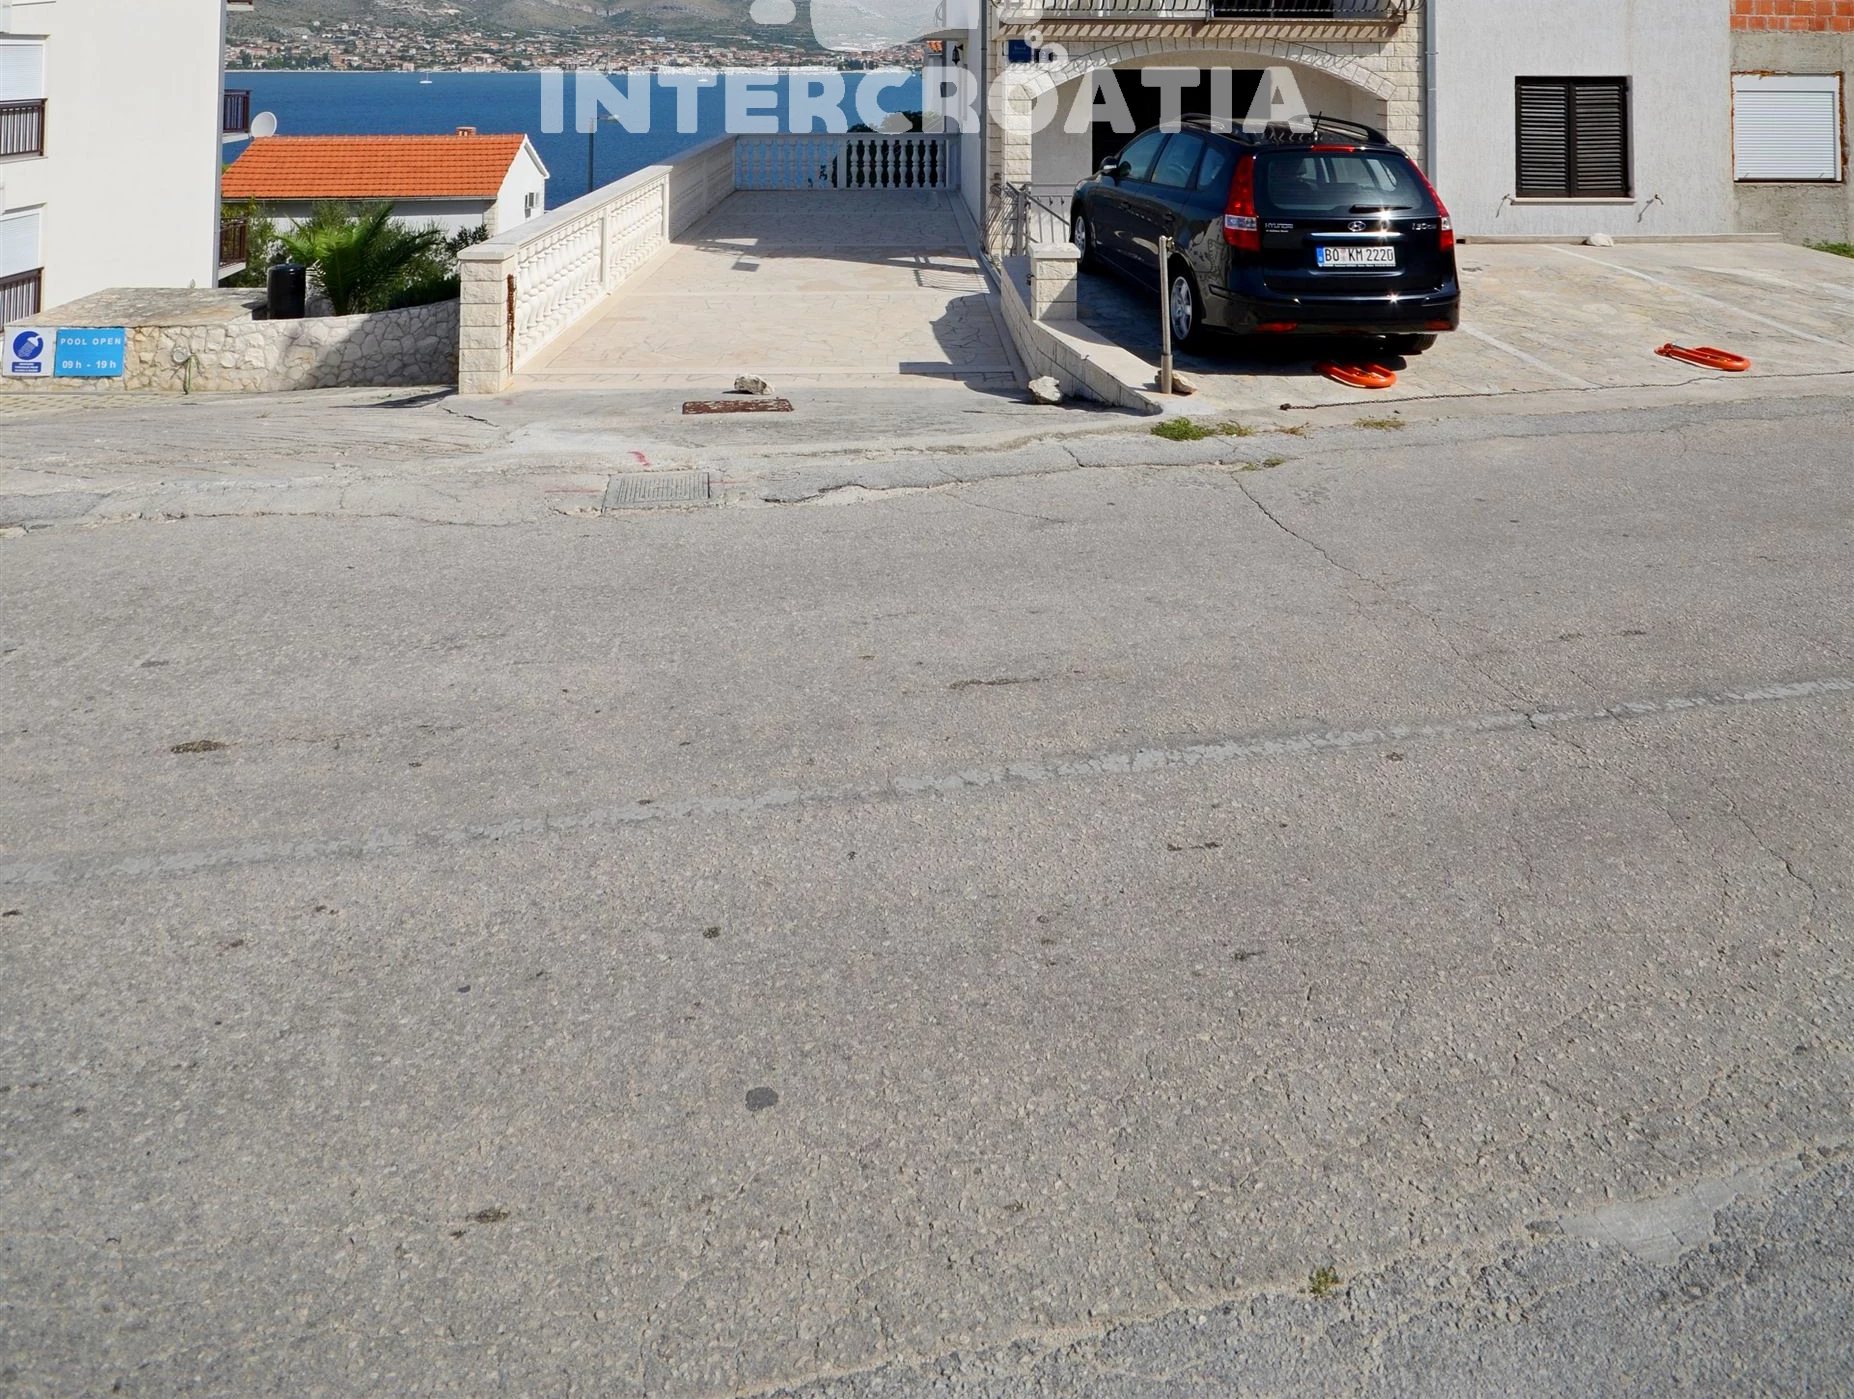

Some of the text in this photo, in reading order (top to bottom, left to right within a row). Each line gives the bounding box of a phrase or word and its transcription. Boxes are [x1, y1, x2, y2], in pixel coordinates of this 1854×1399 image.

[1325, 248, 1394, 261] BO KM 2220
[60, 337, 121, 346] POOL OPEN
